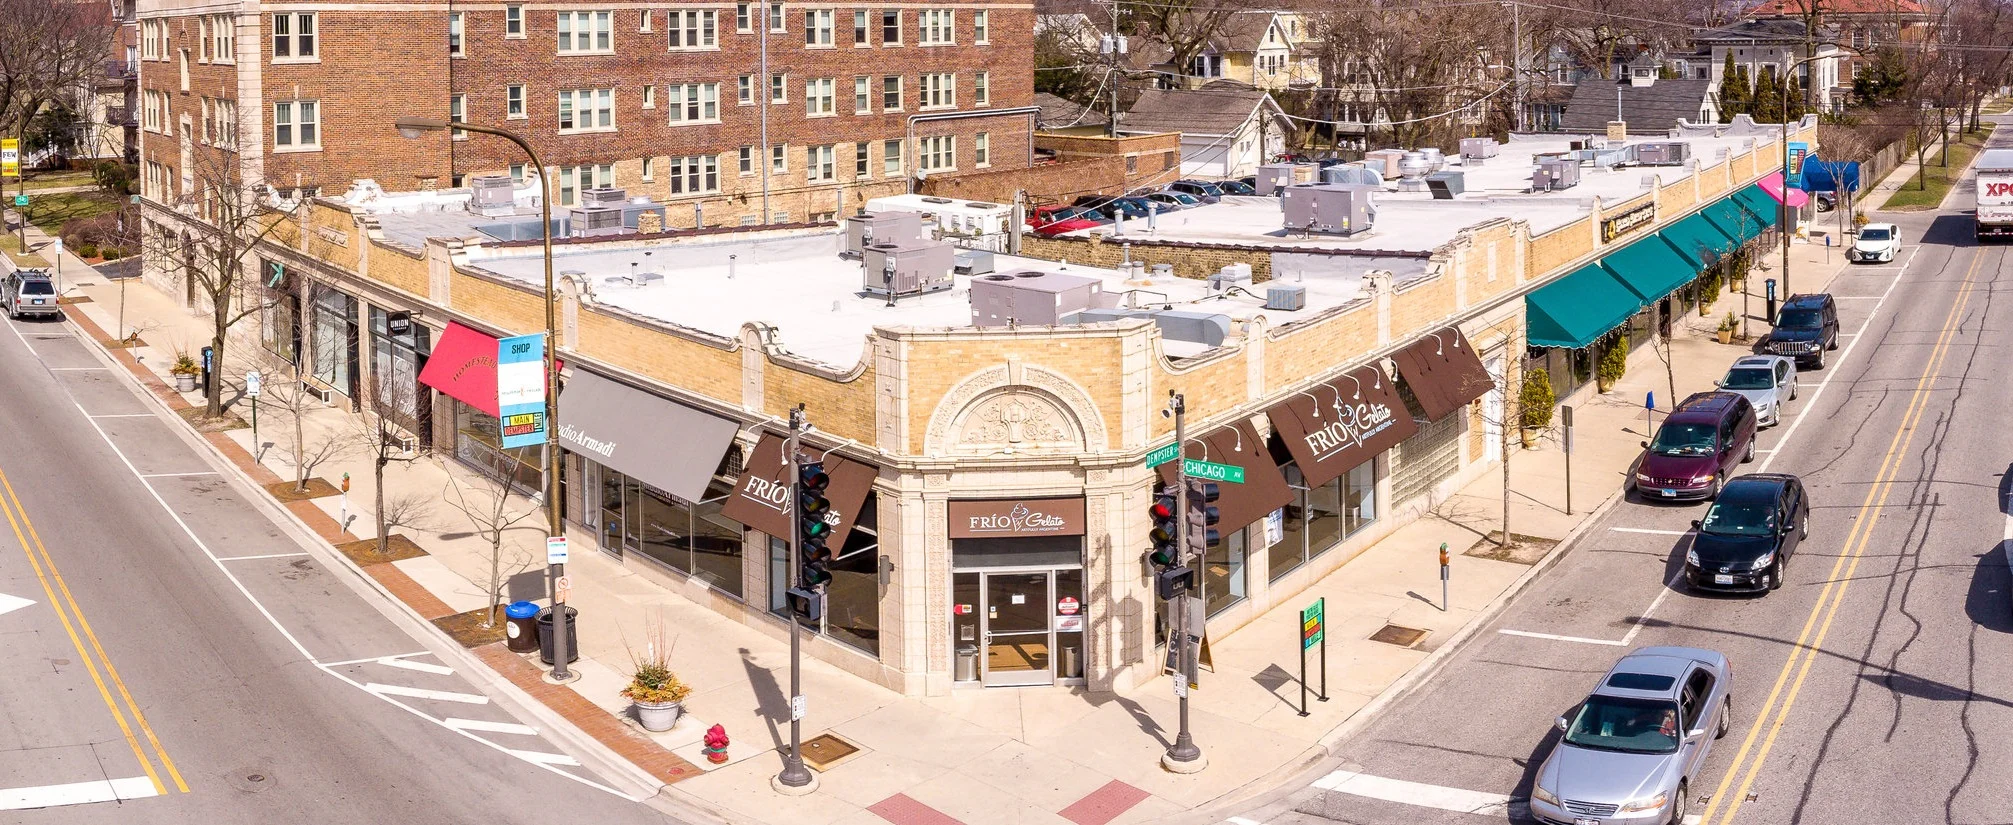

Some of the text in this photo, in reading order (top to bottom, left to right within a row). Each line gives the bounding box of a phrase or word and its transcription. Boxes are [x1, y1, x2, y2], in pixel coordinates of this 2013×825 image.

[390, 319, 409, 328] UNION
[512, 343, 531, 354] SHOP
[513, 415, 530, 425] MAIN
[505, 424, 533, 435] DEMPSTER
[1304, 403, 1391, 456] FRÍO Gelato
[1146, 445, 1174, 466] DEMPSTER
[1185, 461, 1225, 479] CHICAGO
[744, 476, 788, 504] FRÍO
[969, 512, 1065, 529] FRÍO Gelato
